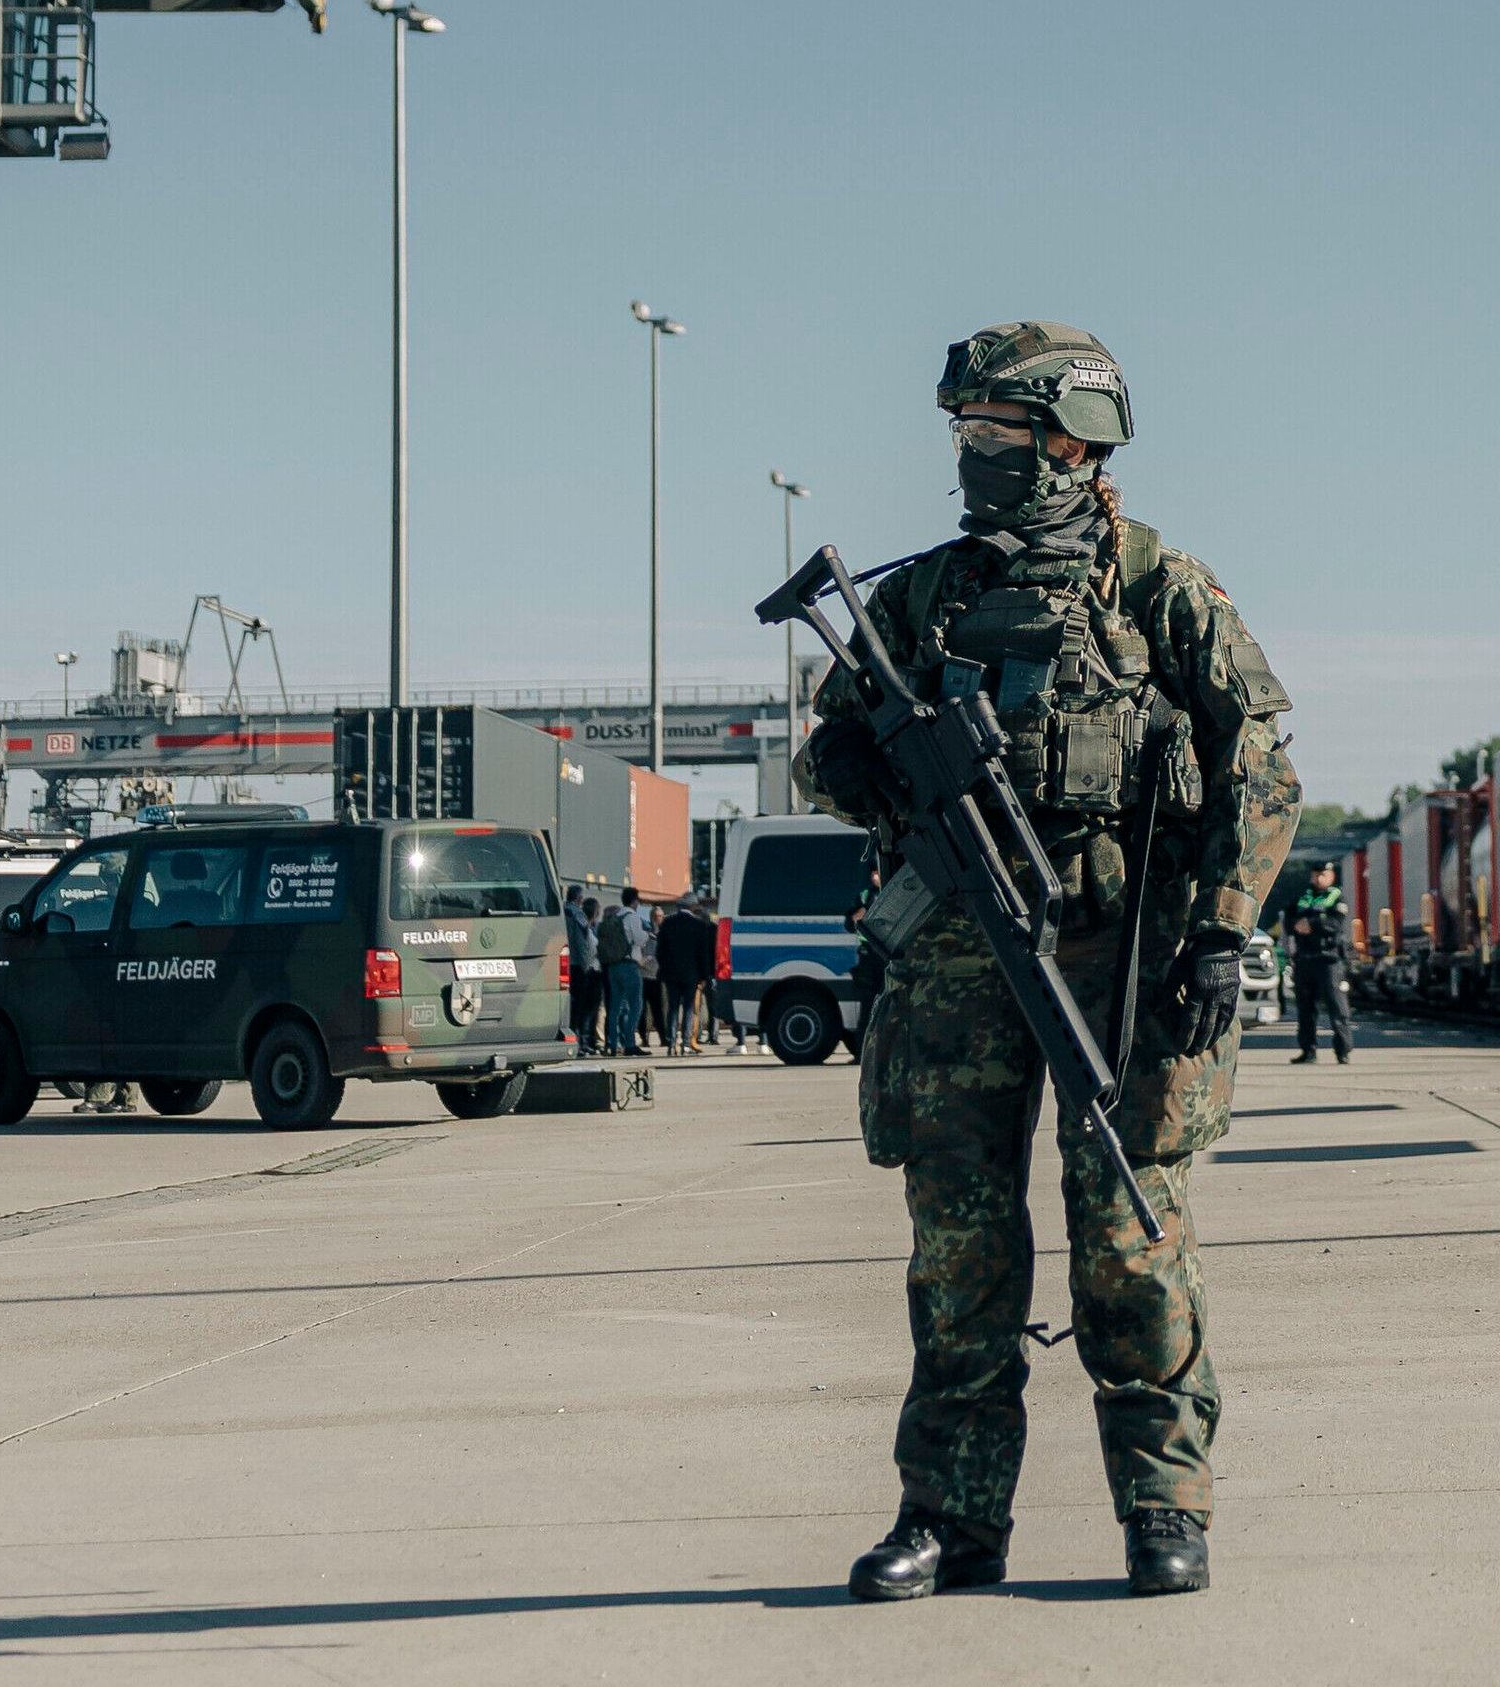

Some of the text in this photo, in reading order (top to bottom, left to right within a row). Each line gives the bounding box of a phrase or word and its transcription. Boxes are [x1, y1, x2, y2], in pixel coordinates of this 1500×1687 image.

[585, 723, 718, 739] DUSS-Trminal
[50, 734, 142, 750] DB NETZE
[402, 929, 468, 945] FELDJÄGER
[116, 957, 217, 981] FELDJÄGER
